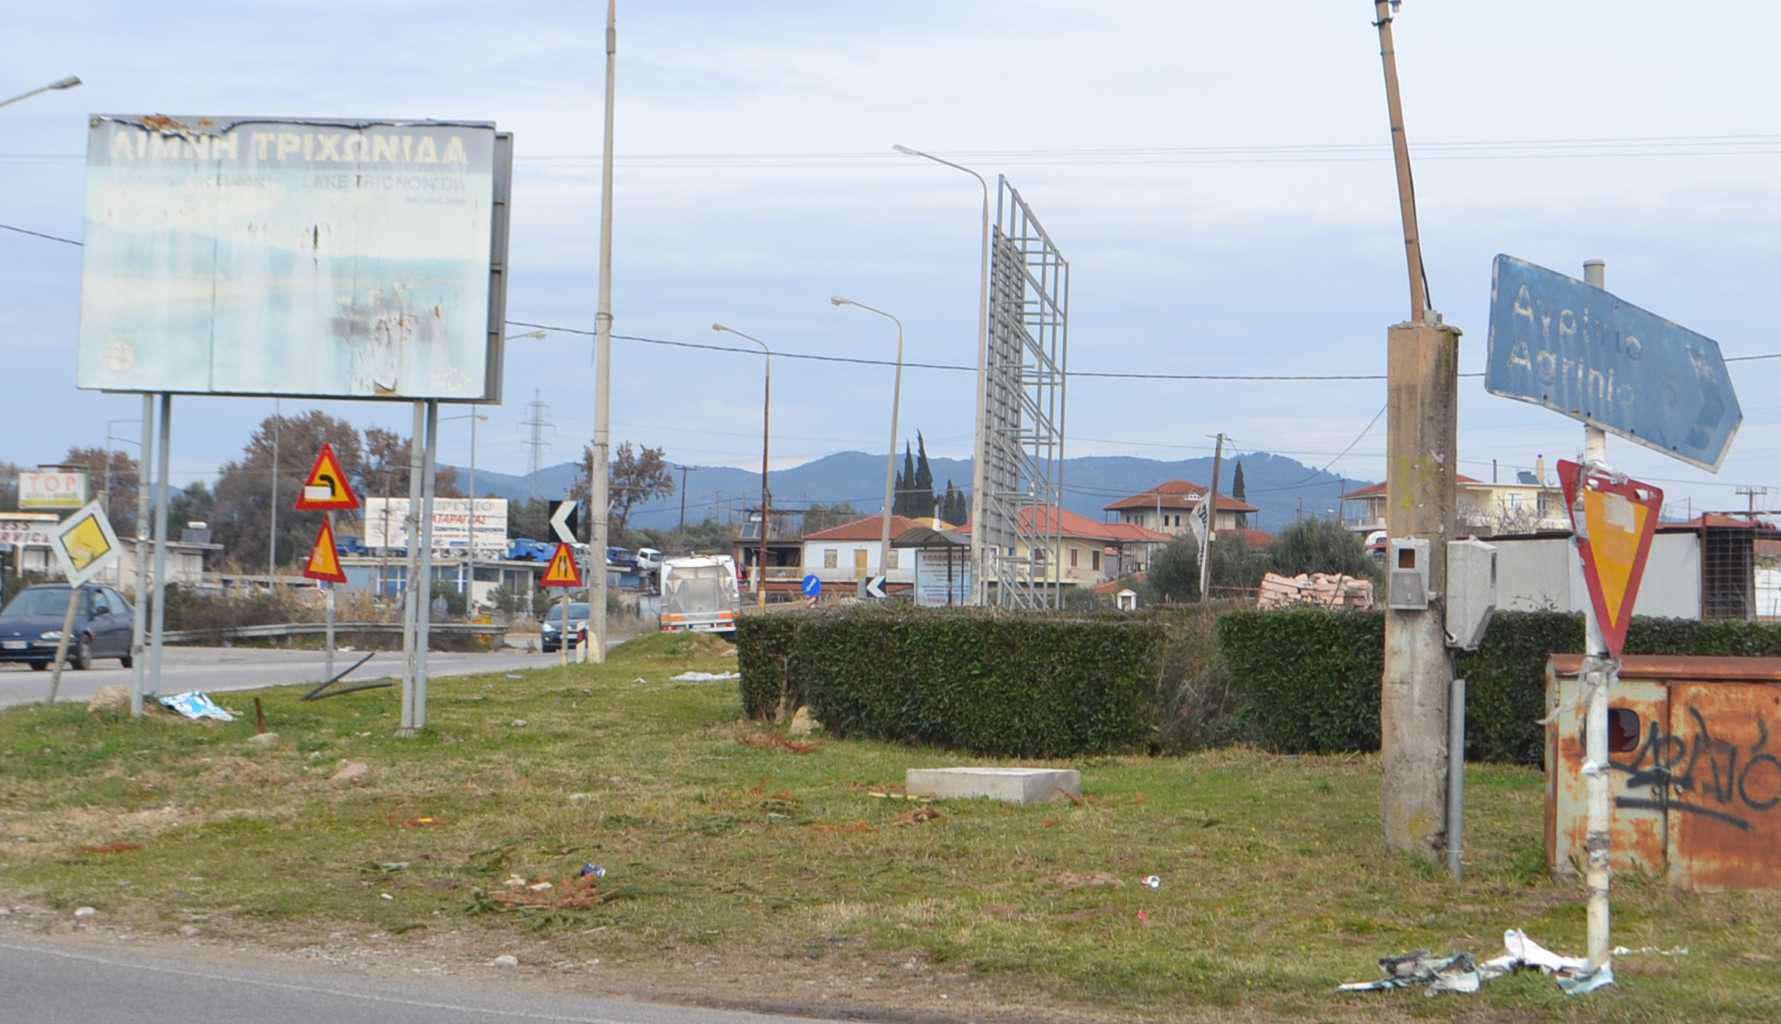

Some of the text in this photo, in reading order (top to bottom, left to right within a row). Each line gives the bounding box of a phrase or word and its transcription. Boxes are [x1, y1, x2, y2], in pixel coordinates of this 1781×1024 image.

[110, 130, 467, 163] ΛΙΜΝΗ ΤΡΙΧΩΝΙΔΑ
[29, 475, 77, 492] TOP
